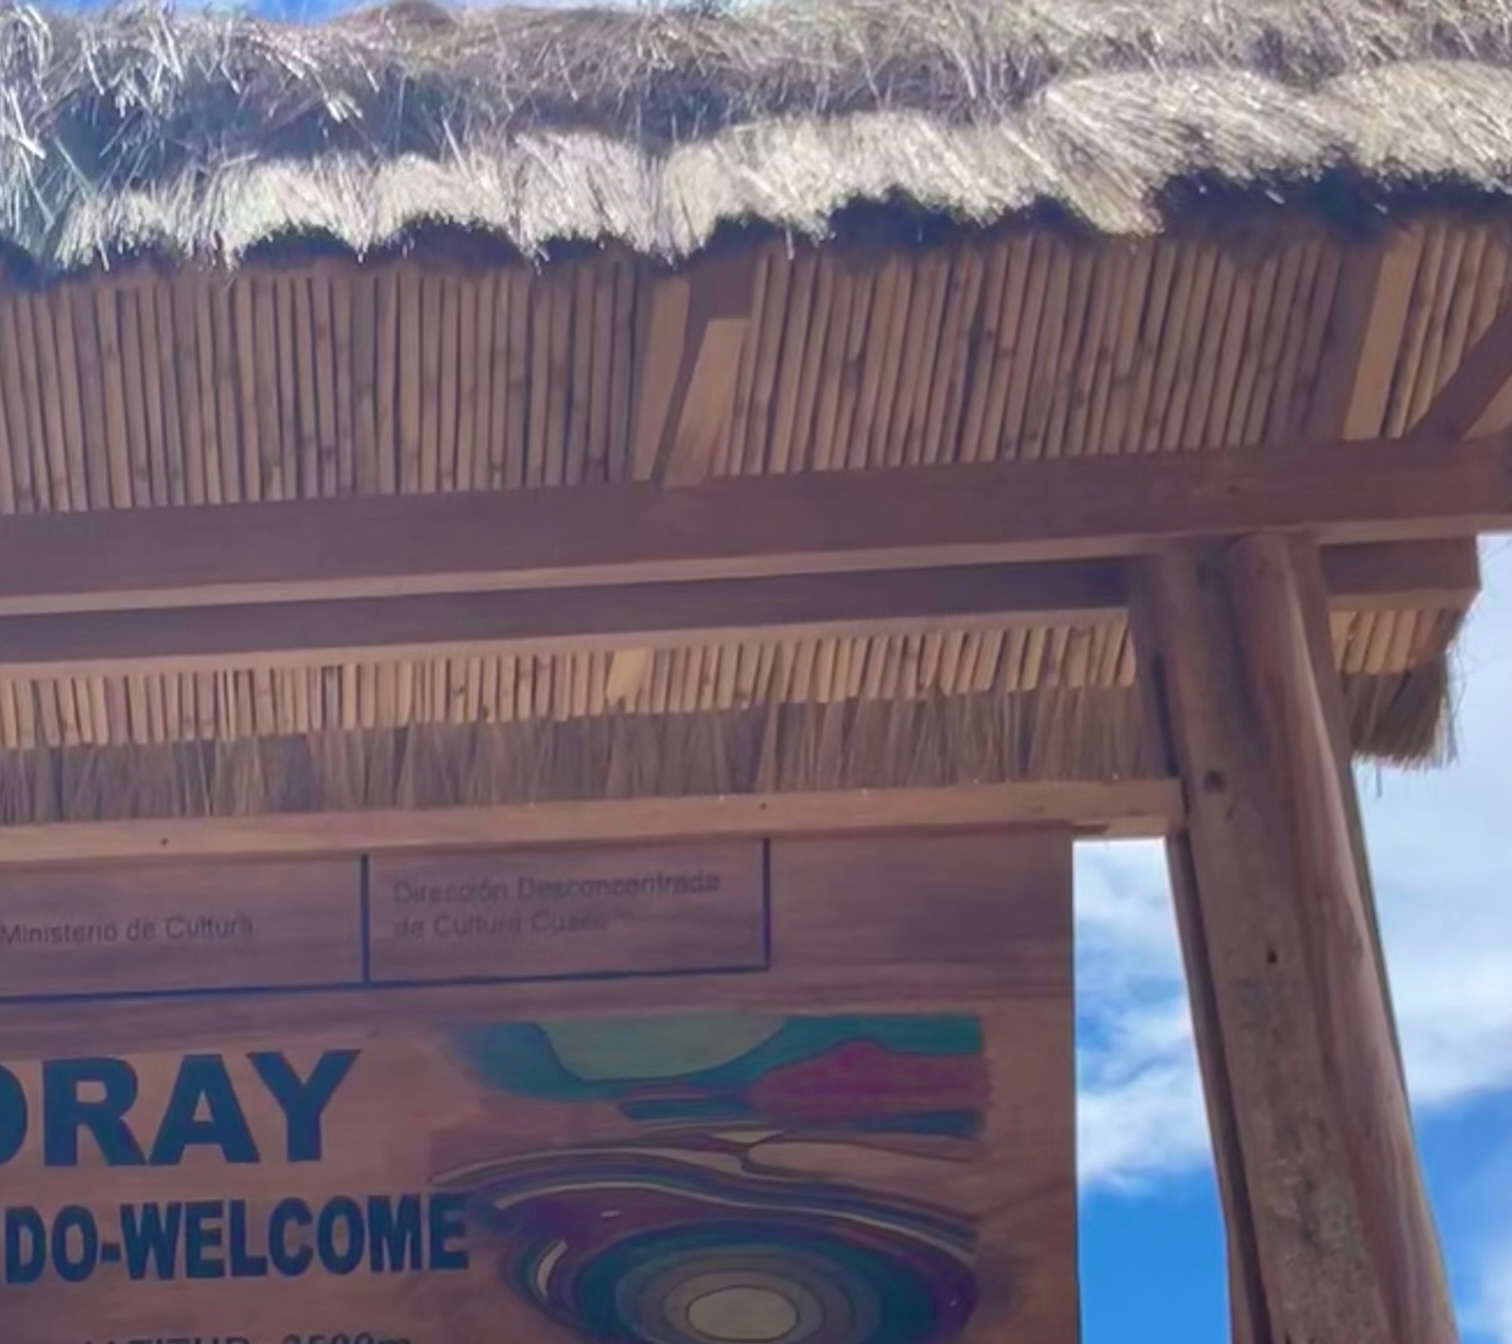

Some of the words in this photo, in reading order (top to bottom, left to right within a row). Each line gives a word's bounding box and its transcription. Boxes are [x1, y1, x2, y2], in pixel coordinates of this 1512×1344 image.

[126, 918, 155, 942] de
[165, 914, 253, 940] Cultura
[394, 916, 422, 938] de
[434, 910, 522, 937] Cultura
